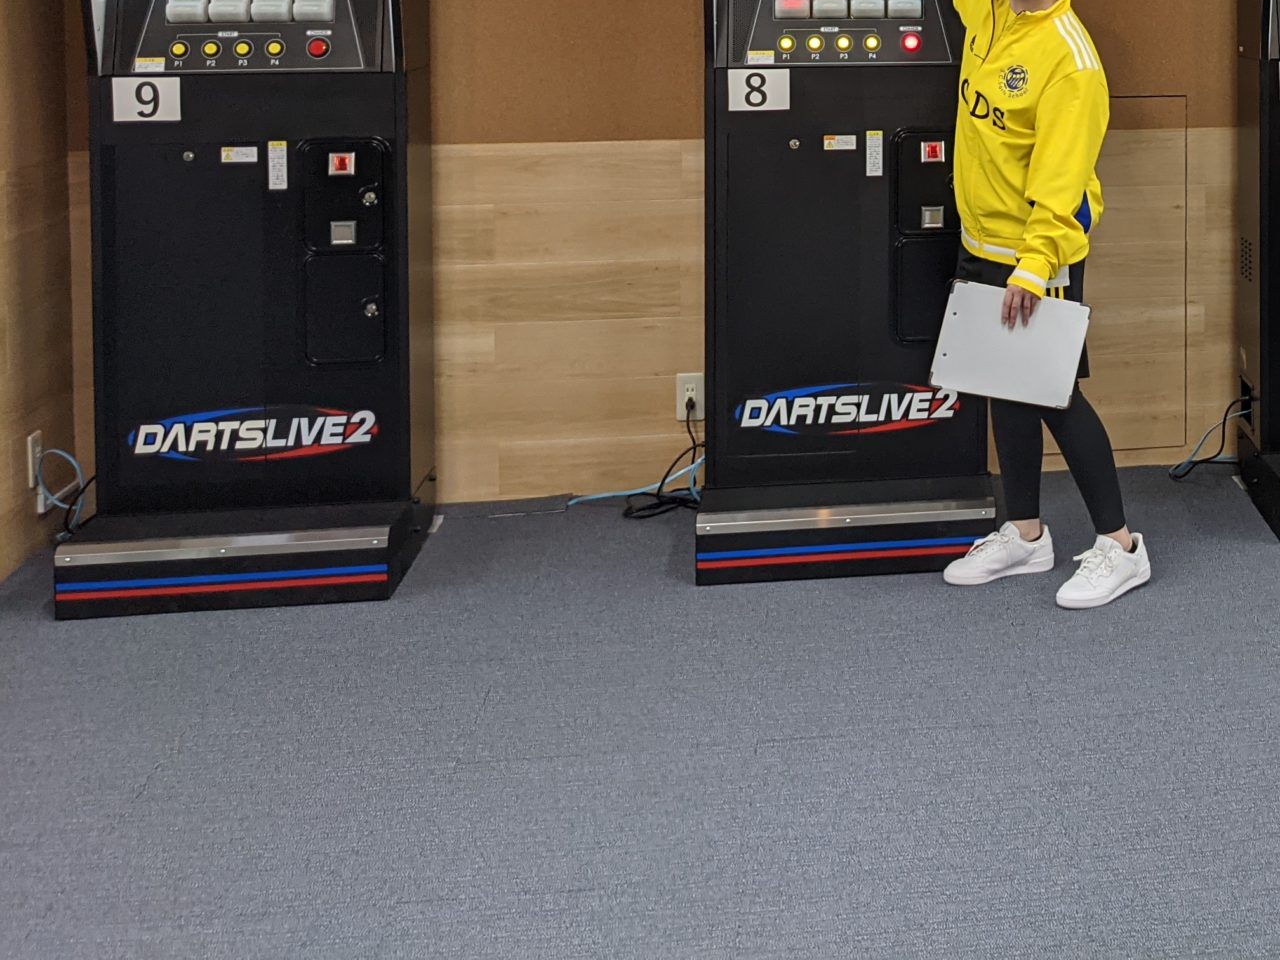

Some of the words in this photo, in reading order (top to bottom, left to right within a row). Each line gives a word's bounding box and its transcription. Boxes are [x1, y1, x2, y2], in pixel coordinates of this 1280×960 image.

[134, 81, 160, 119] 9
[744, 72, 768, 107] 8
[740, 390, 959, 428] DARTSLIVE2
[134, 409, 376, 454] DARTSLIVE2
